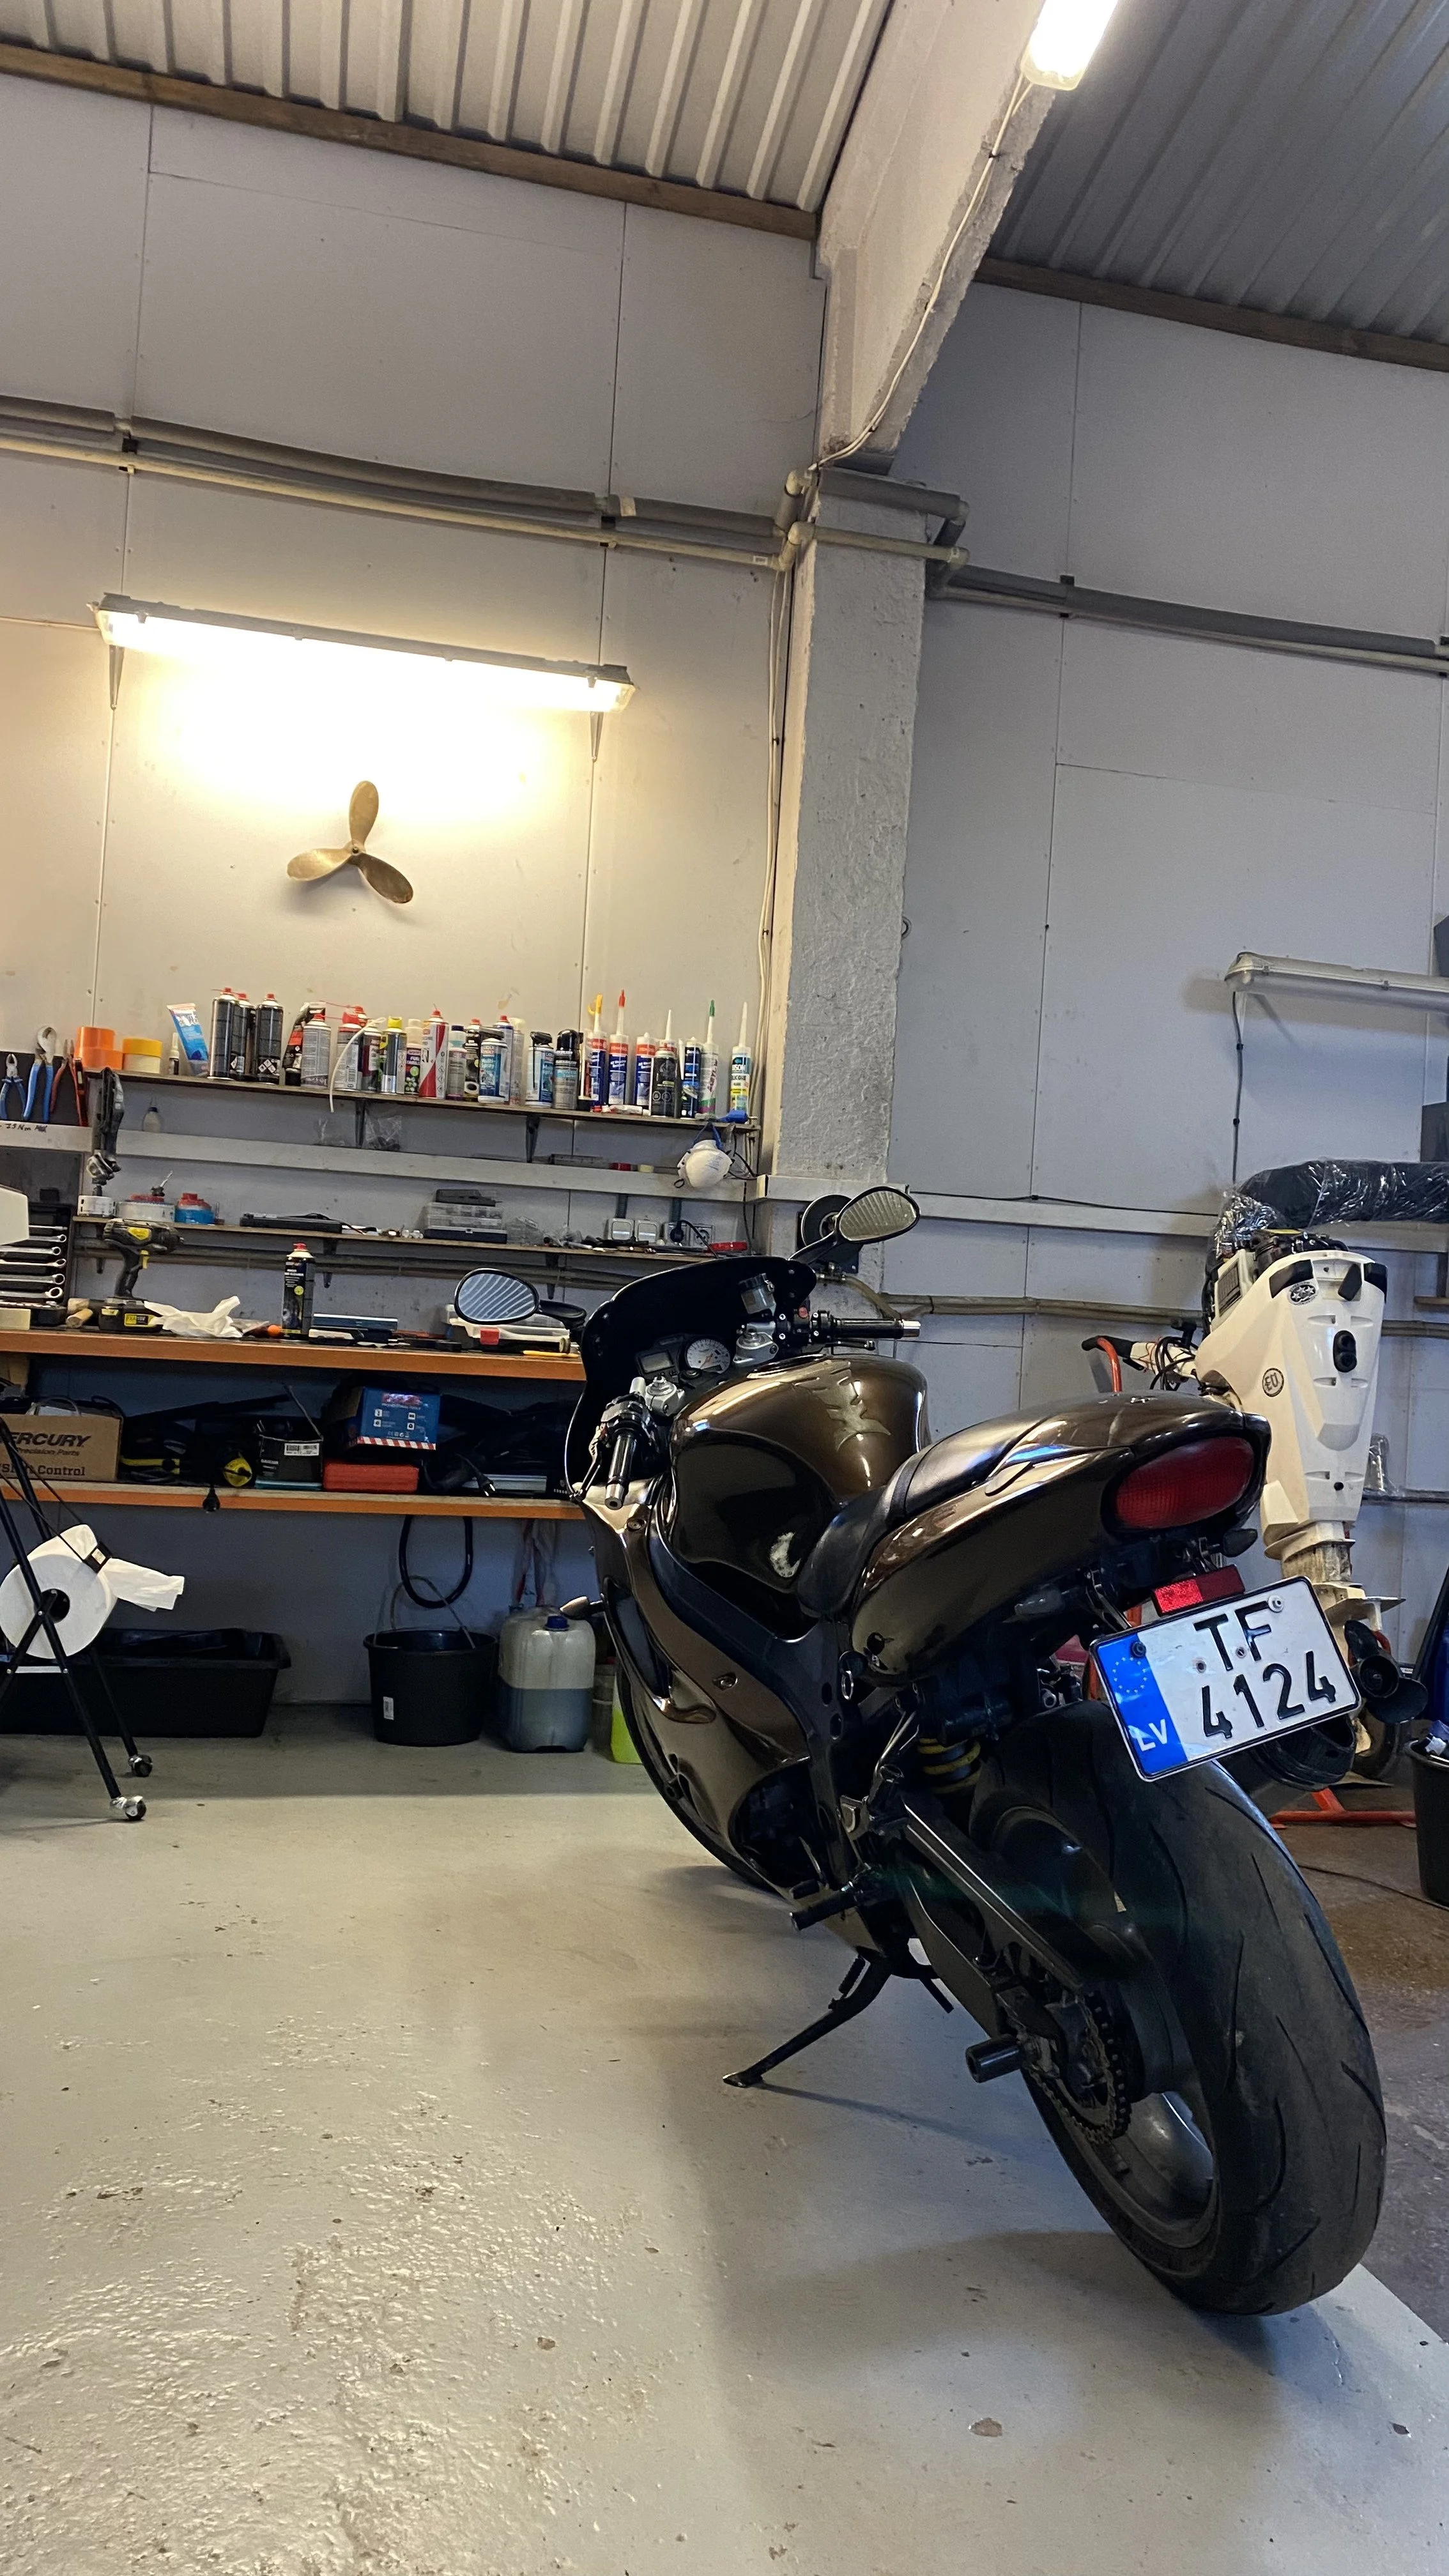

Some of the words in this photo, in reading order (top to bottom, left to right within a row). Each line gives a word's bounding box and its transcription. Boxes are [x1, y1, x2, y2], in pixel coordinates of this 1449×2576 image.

[0, 1431, 91, 1448] ERCURY
[18, 1447, 55, 1455] Precision
[38, 1465, 86, 1476] Control
[1193, 1600, 1272, 1671] TF
[1202, 1651, 1336, 1740] 4124
[1134, 1719, 1167, 1752] LV
